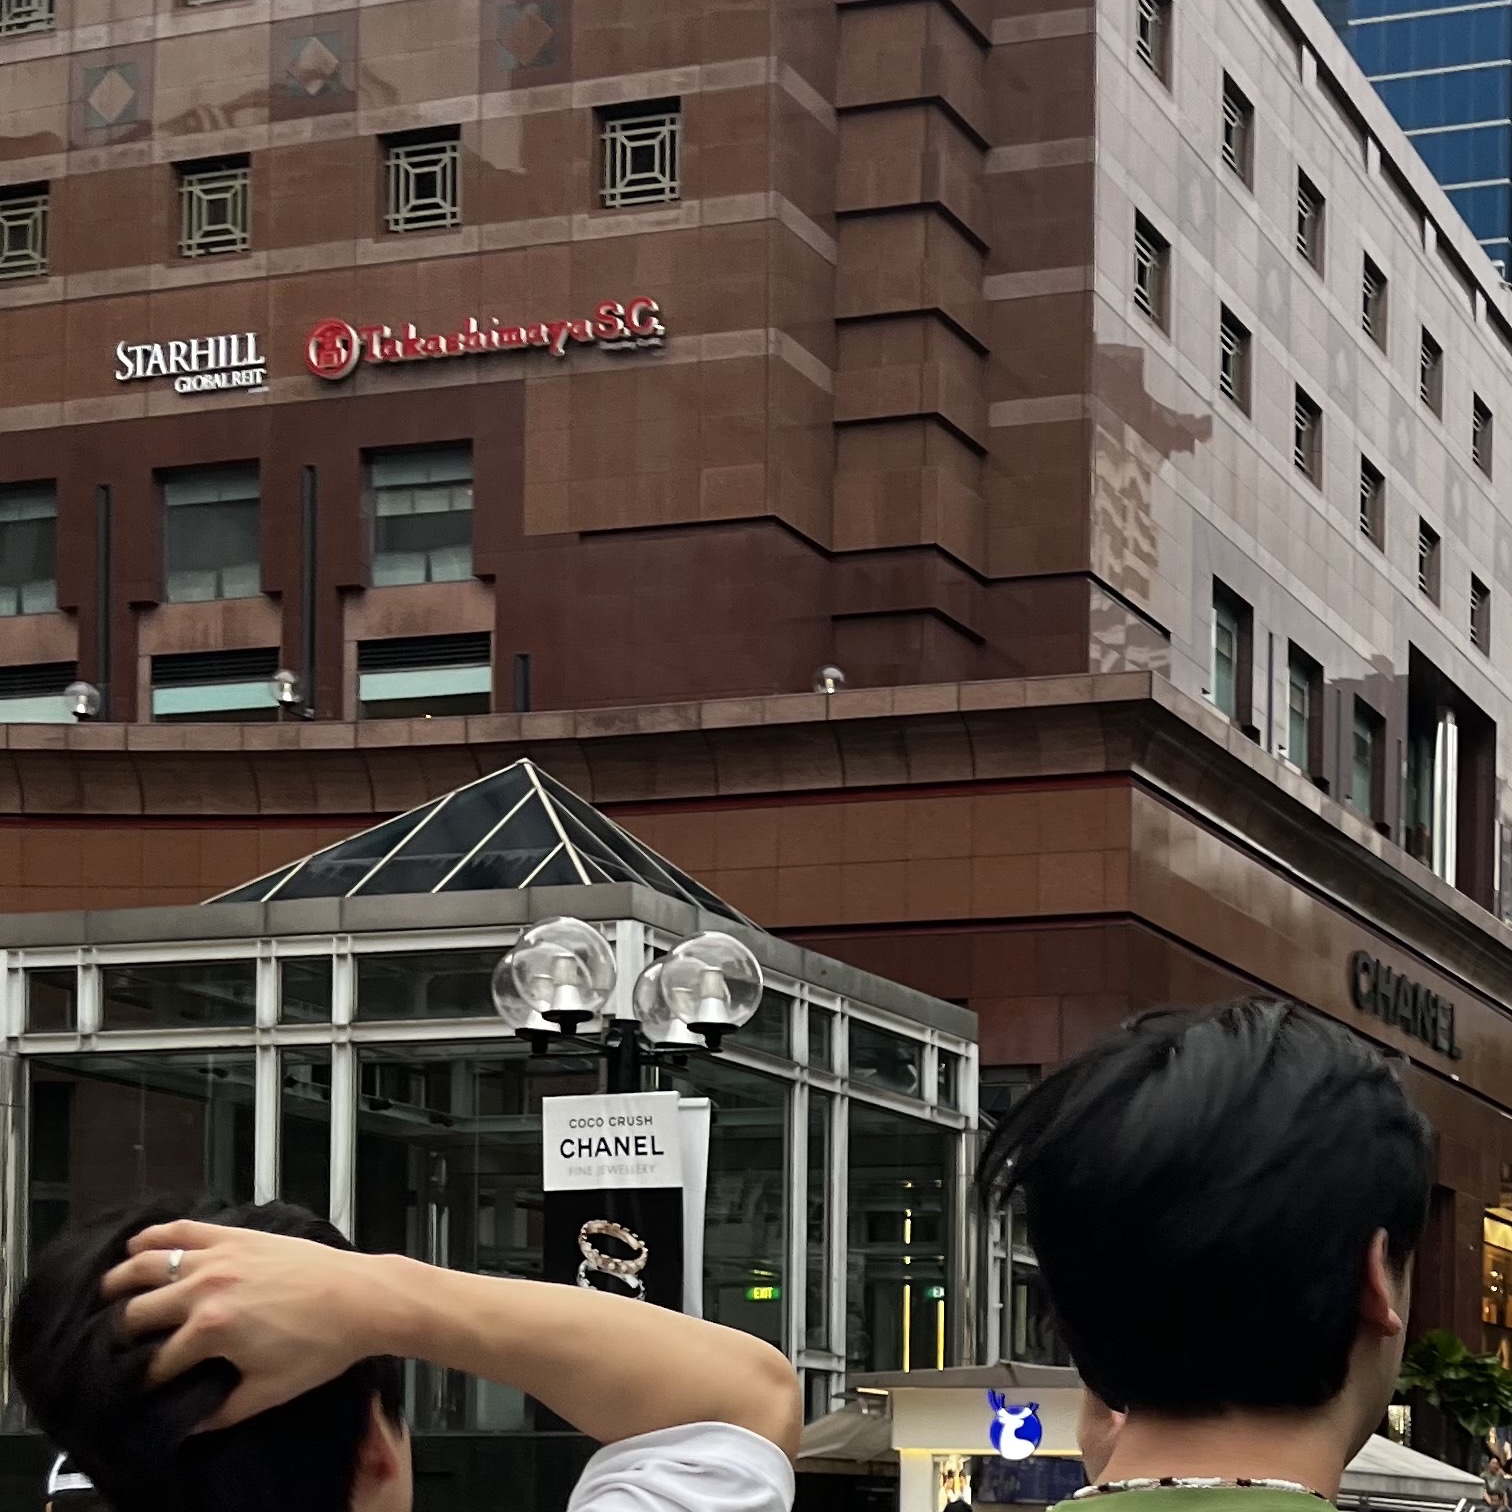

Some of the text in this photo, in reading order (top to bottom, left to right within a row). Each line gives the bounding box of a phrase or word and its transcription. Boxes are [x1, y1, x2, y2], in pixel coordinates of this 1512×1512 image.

[357, 316, 595, 363] Takashimaya
[115, 332, 265, 380] STARHILL
[174, 368, 267, 393] GLOBAL REIT
[1351, 951, 1462, 1060] CHANEL
[569, 1115, 653, 1129] COCO CRUSH
[560, 1135, 664, 1159] CHANEL
[568, 1163, 657, 1177] FINE JEWELLERY
